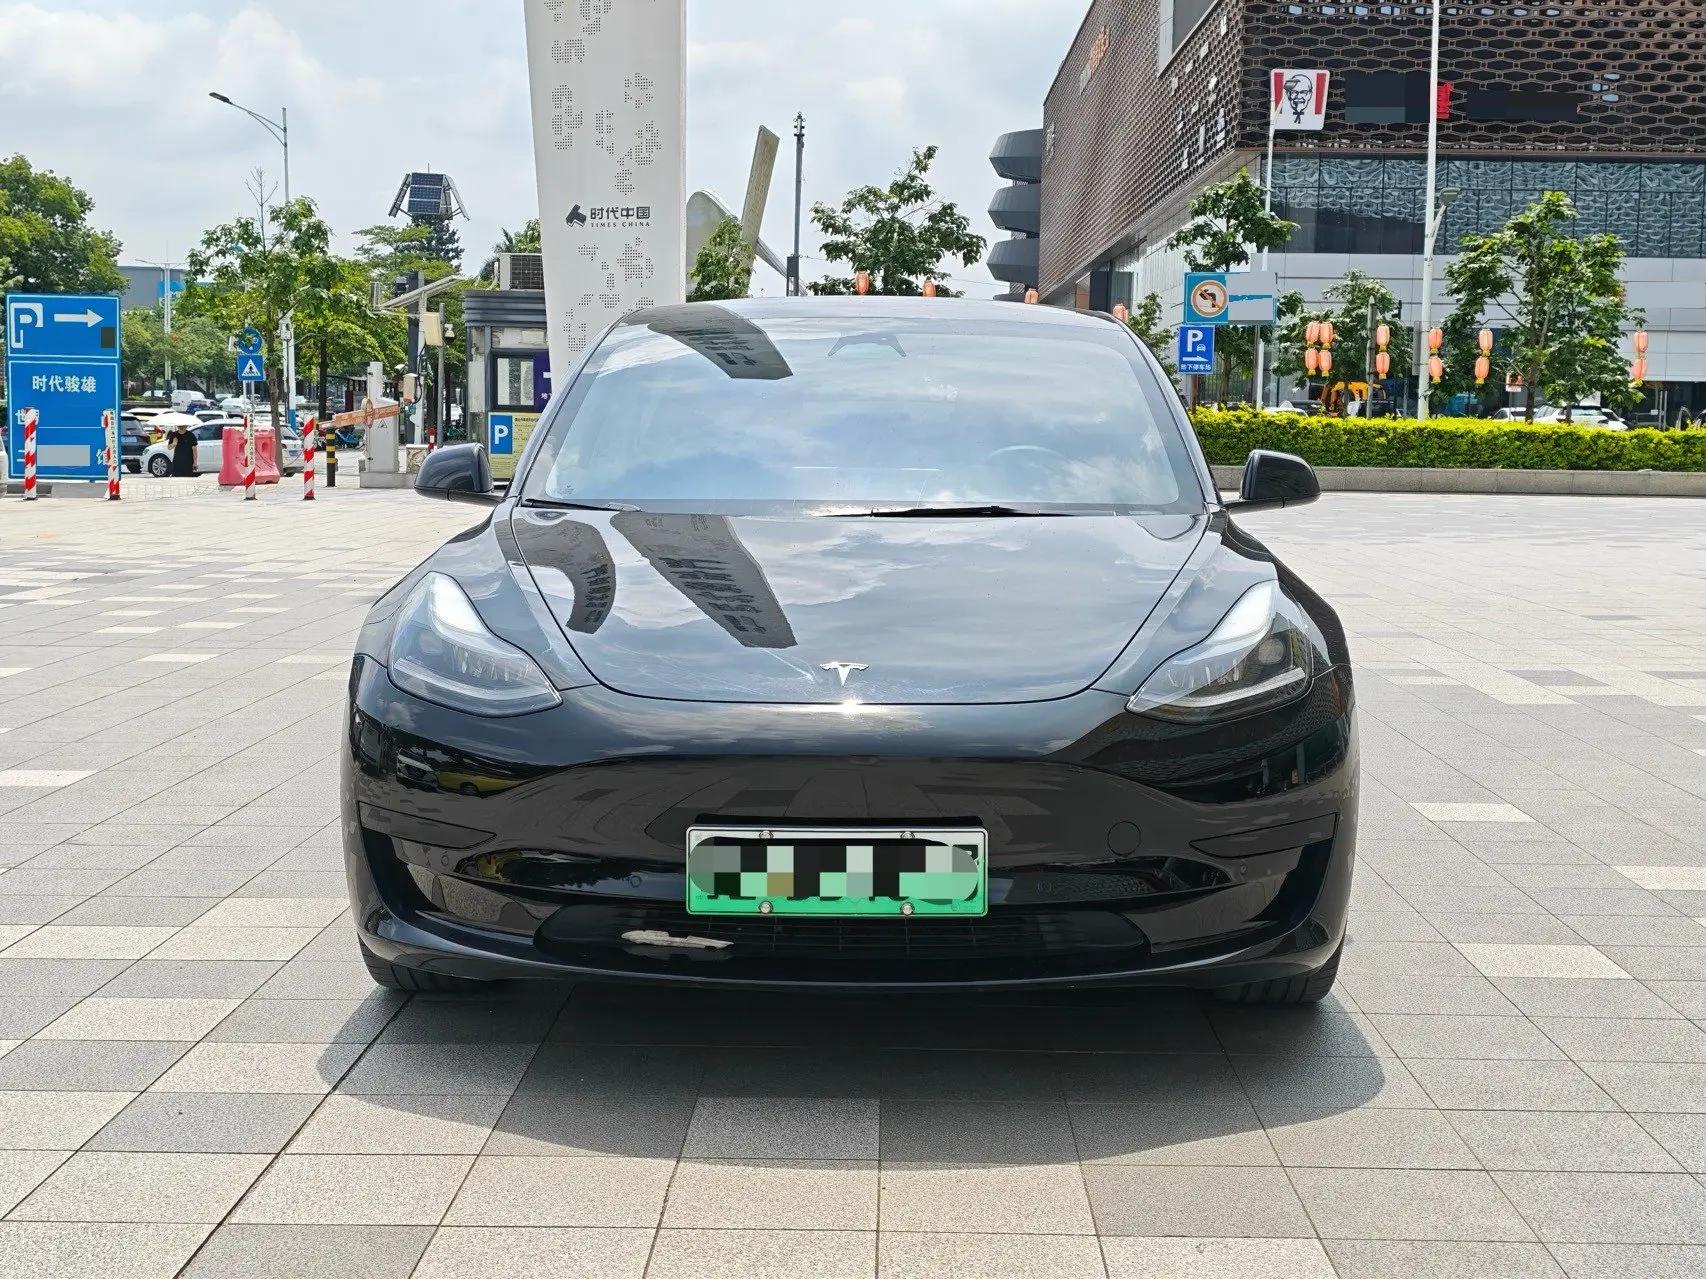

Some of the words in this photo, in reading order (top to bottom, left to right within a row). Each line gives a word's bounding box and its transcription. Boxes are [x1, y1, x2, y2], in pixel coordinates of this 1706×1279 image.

[590, 206, 650, 220] 时代中国
[10, 302, 43, 348] P
[1187, 329, 1204, 352] P
[32, 375, 97, 393] 时代骏雄
[494, 424, 509, 445] P
